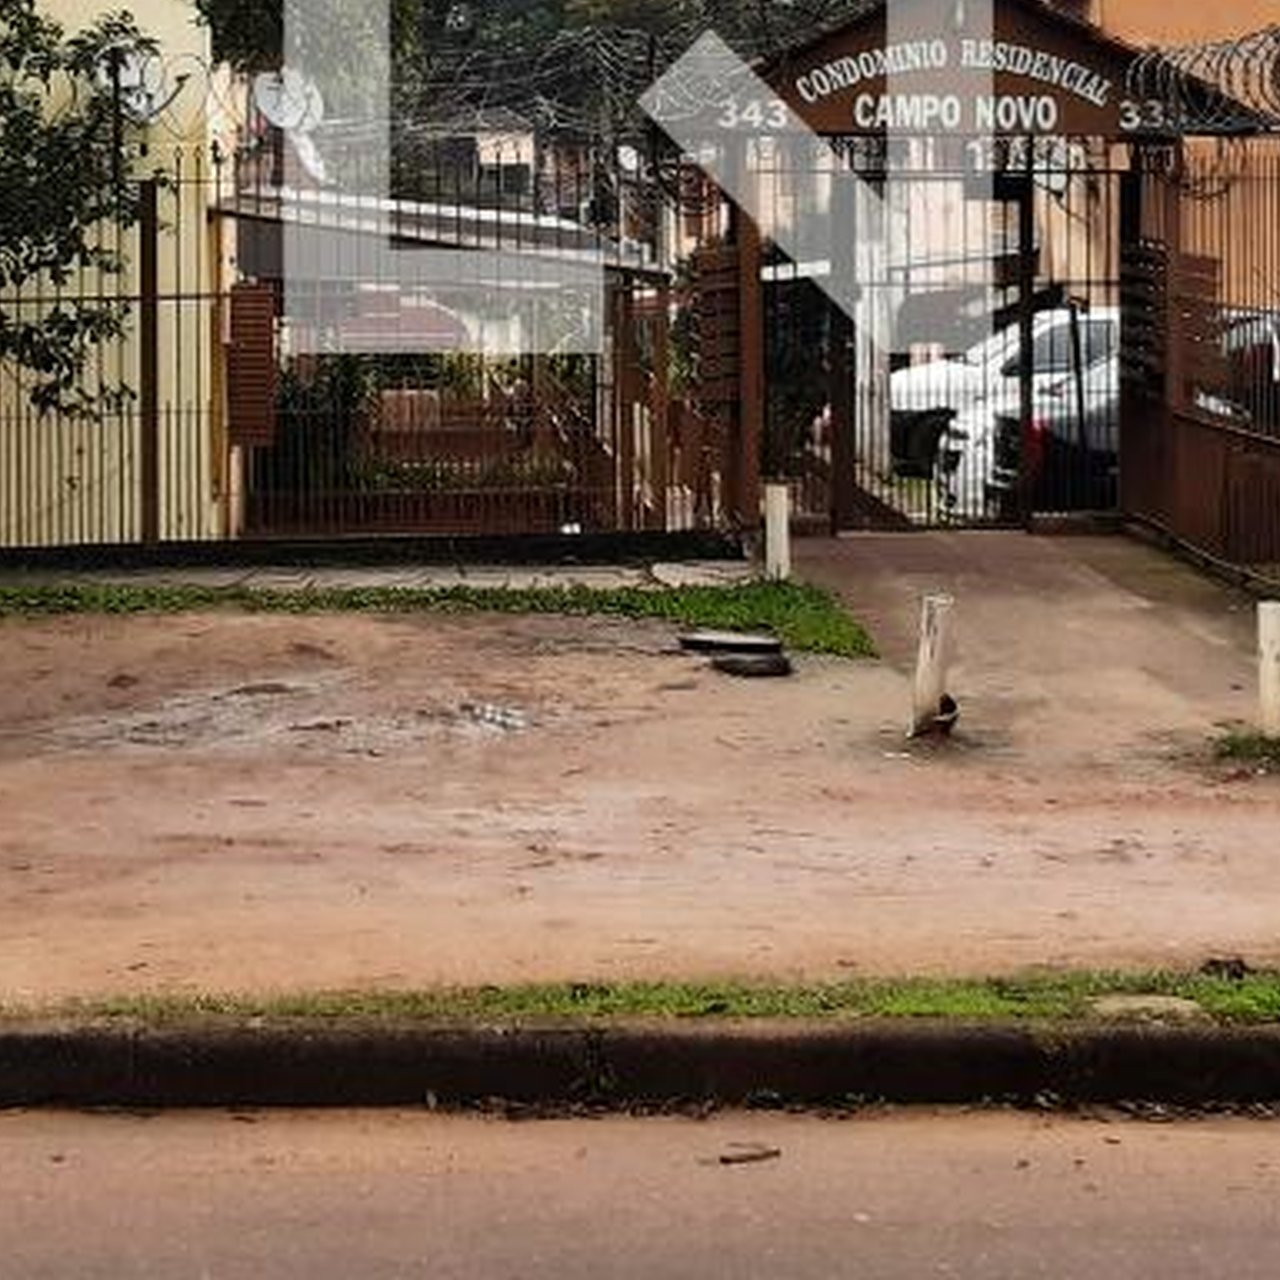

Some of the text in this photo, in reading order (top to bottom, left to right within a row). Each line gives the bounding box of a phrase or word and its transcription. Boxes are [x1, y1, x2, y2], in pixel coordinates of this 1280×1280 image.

[796, 38, 1112, 107] CONDOMINIO RESIDENCIAL
[719, 100, 787, 128] 343
[854, 94, 1057, 130] CAMPO NOVO
